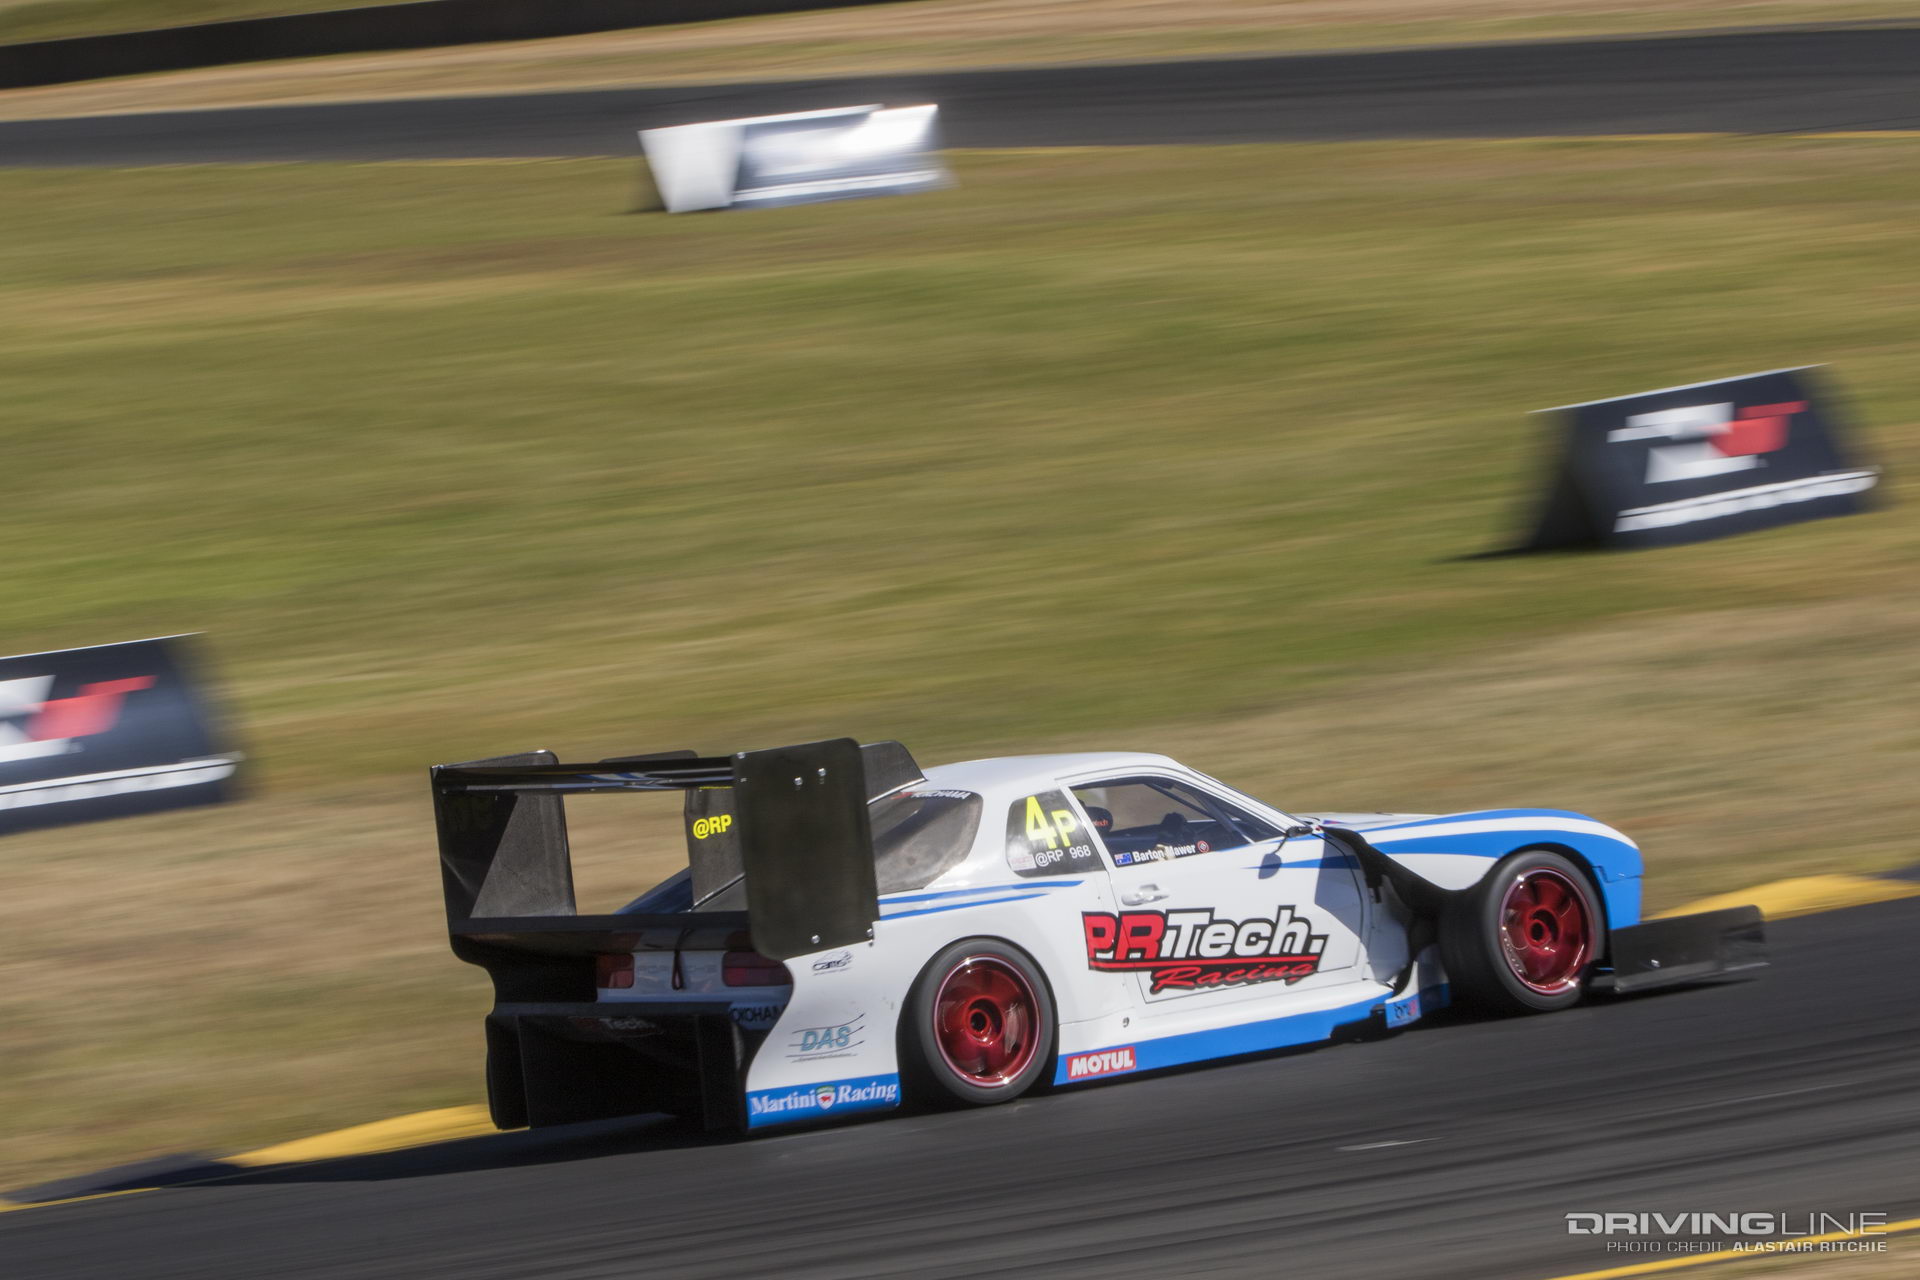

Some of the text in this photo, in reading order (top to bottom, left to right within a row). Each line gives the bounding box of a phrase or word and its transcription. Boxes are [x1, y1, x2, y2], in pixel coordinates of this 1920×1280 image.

[693, 814, 732, 840] @RP
[1035, 845, 1091, 867] @RP 968
[1132, 849, 1164, 862] Barton
[1154, 963, 1313, 990] Racing
[801, 1026, 850, 1052] DAS
[1071, 1049, 1133, 1076] MOTUL
[751, 1082, 898, 1115] Martini Racing
